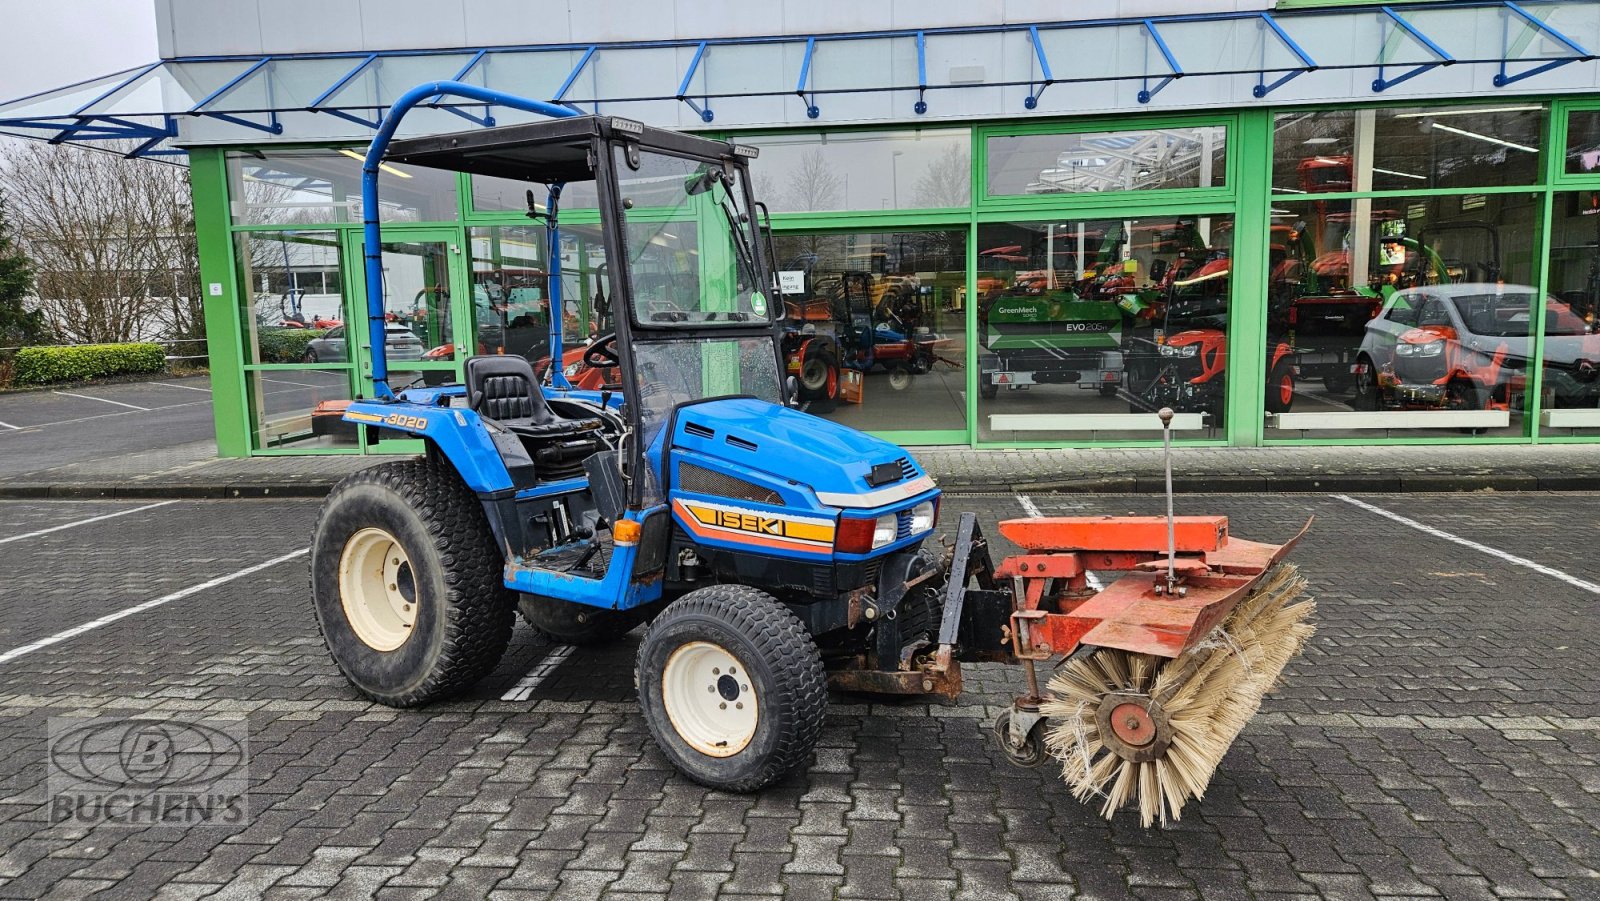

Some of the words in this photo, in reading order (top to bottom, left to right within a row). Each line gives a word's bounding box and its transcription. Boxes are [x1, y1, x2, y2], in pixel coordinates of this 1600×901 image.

[998, 306, 1037, 314] GreenMech
[1066, 323, 1085, 331] EVO
[387, 412, 428, 430] 3020
[717, 510, 785, 536] ISEKI
